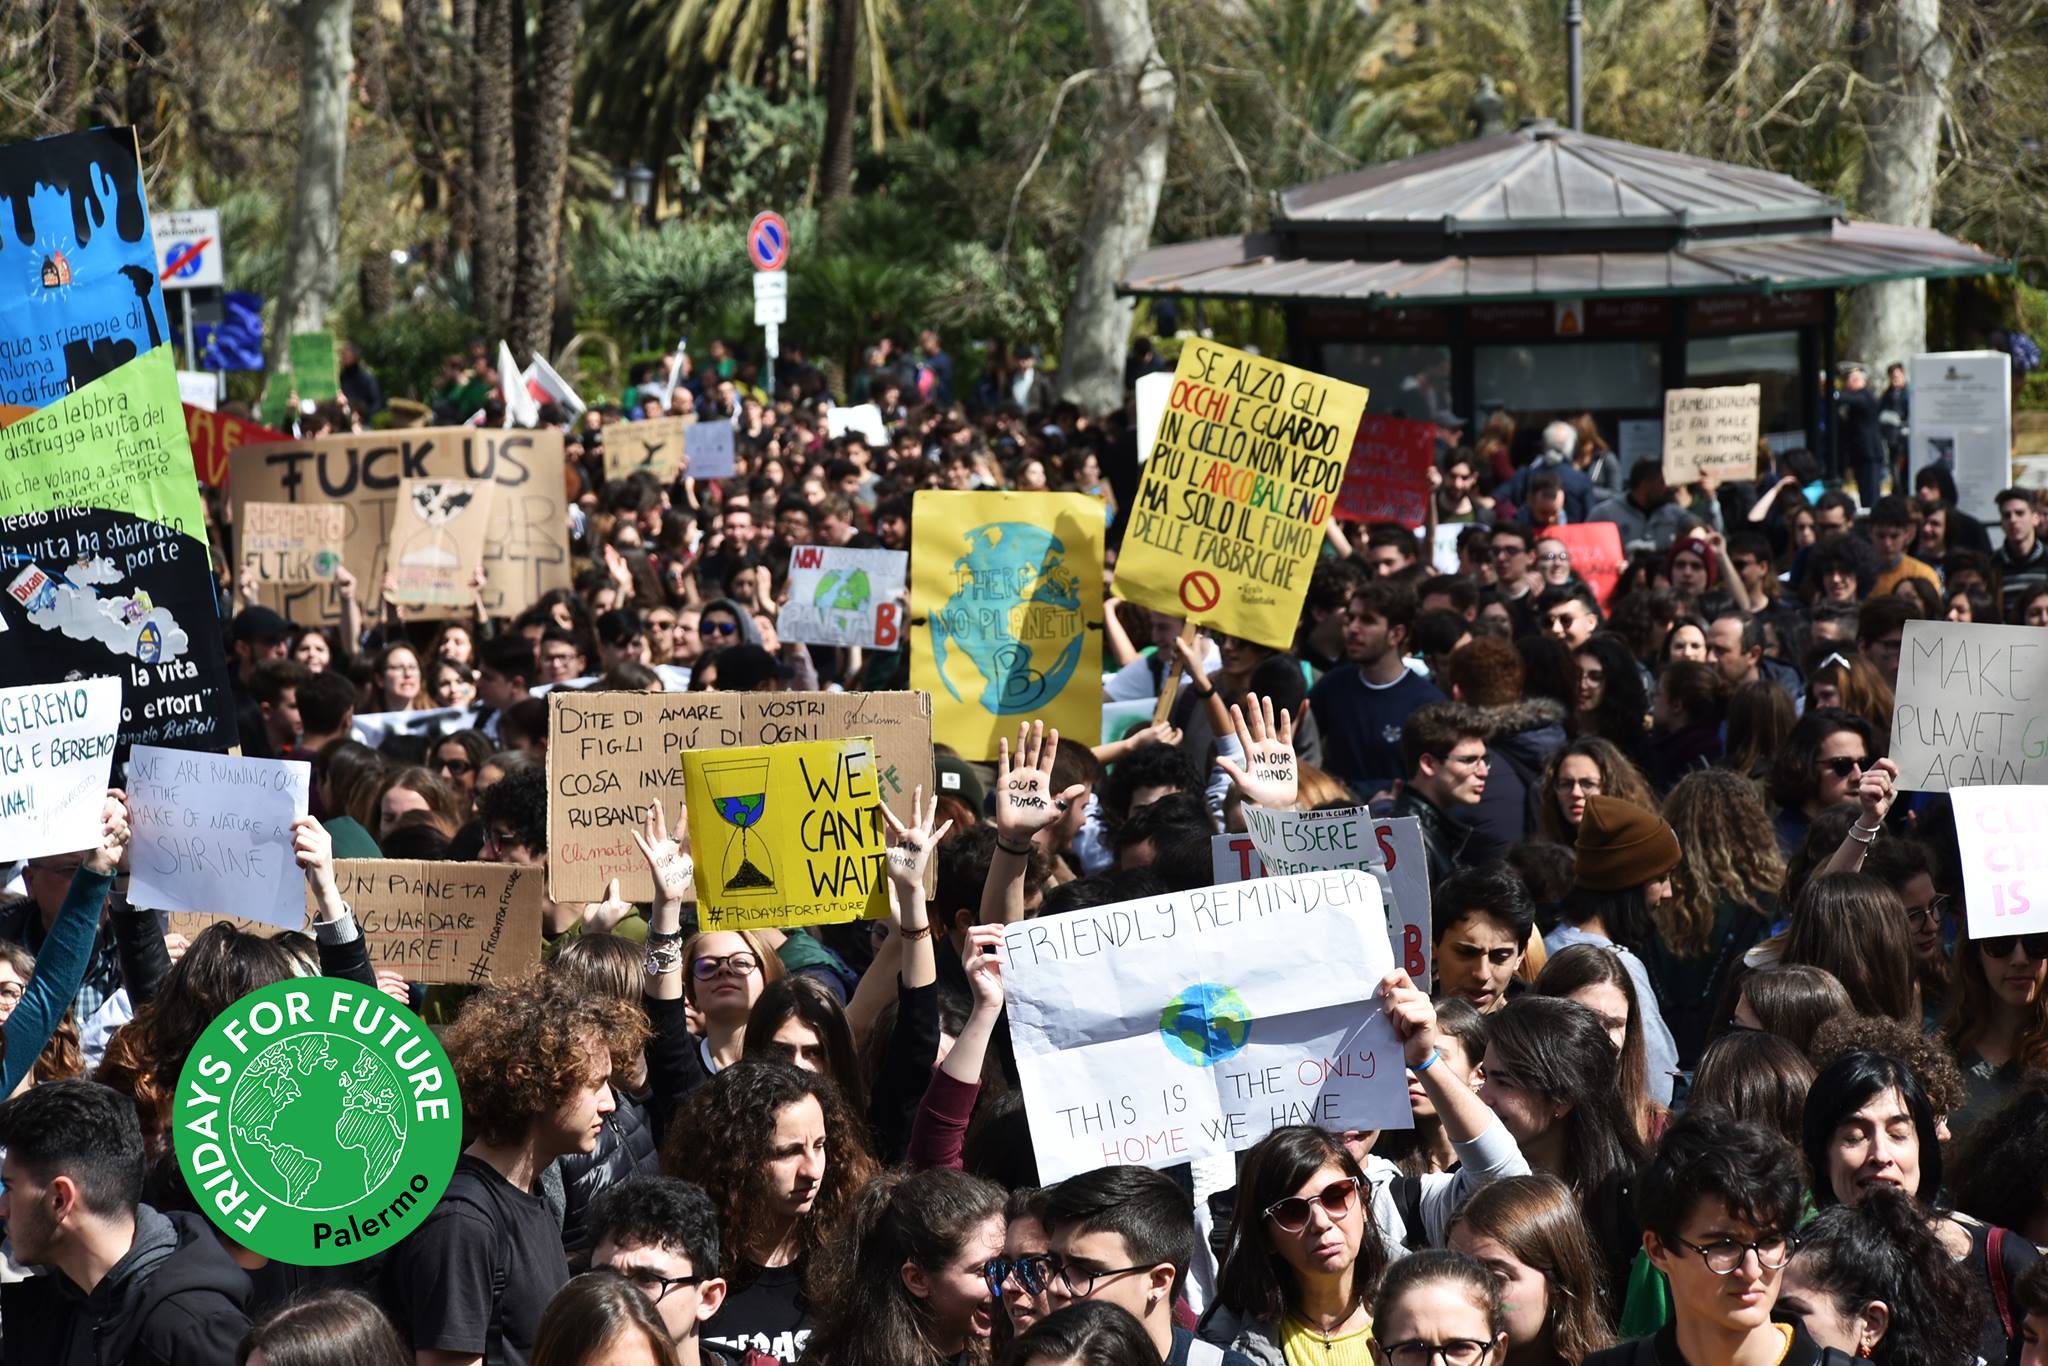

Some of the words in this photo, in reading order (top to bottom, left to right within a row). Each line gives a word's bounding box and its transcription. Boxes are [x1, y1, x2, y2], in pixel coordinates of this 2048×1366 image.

[39, 333, 52, 351] si
[55, 316, 121, 347] riempie
[126, 302, 142, 329] di
[22, 380, 38, 403] di
[1189, 347, 1223, 384] SE
[1224, 360, 1285, 403] ALZO
[1291, 382, 1327, 417] GLI
[63, 392, 128, 424] lebbra
[1170, 380, 1229, 423] OCCHI
[1230, 398, 1250, 428] E
[1251, 405, 1339, 456] GUARDO
[4, 429, 85, 461] distrugge
[116, 432, 162, 459] fiumi
[1160, 410, 1184, 444] IN
[1188, 419, 1247, 463] CIELO
[1246, 436, 1288, 477] NON
[1291, 450, 1342, 494] VEDO
[15, 472, 41, 496] che
[45, 466, 90, 489] volano
[96, 466, 106, 482] a
[110, 451, 170, 476] stento
[105, 475, 120, 491] di
[125, 464, 169, 484] morte
[266, 441, 435, 501] FUCK
[463, 436, 534, 486] US
[1140, 478, 1168, 514] MA
[1176, 489, 1234, 534] SOLO
[1236, 507, 1254, 543] IL
[1258, 515, 1313, 559] FUMO
[26, 537, 70, 563] vita
[76, 529, 100, 552] ha
[106, 516, 184, 549] sbarrato
[1133, 511, 1190, 555] DELLE
[1193, 531, 1300, 590] FABBRICHE
[126, 541, 180, 577] porte
[14, 571, 45, 601] Dixan
[950, 567, 1036, 600] THERE
[874, 602, 897, 646] B
[938, 606, 970, 640] NO
[979, 606, 1079, 641] PLANET
[131, 663, 150, 687] la
[156, 659, 199, 683] vita
[993, 643, 1045, 708] B
[1912, 637, 2039, 701] MAKE
[162, 716, 218, 740] Bertoli
[624, 710, 643, 726] DI
[659, 705, 724, 724] AMARE
[759, 700, 825, 719] VOSTRI
[1897, 704, 2014, 756] PLANET
[31, 742, 43, 769] E
[50, 733, 115, 767] BERREMO
[580, 736, 643, 760] FIGLI
[721, 729, 742, 746] DI
[760, 723, 818, 744] OGNI
[1253, 752, 1266, 764] IN
[1270, 752, 1292, 765] OUR
[133, 755, 165, 782] WE
[175, 759, 201, 784] ARE
[210, 761, 268, 788] RUNNING
[559, 770, 621, 797] COSA
[799, 752, 871, 803] WE
[1008, 780, 1038, 791] OUR
[1256, 768, 1293, 782] HANDS
[1920, 754, 2025, 788] AGAIN
[150, 784, 182, 805] TIME
[1008, 794, 1047, 810] FUTURE
[130, 805, 174, 826] MAKE
[183, 807, 199, 828] OF
[210, 812, 263, 835] NATURE
[273, 825, 284, 838] A
[800, 806, 882, 852] CAN'T
[1245, 808, 1276, 845] NON
[1281, 821, 1358, 852] ESSERE
[153, 836, 266, 879] SHRINE
[656, 854, 675, 869] OUR
[807, 853, 887, 898] WAIT
[334, 872, 375, 895] UN
[389, 874, 487, 900] PIANETA
[664, 866, 692, 887] FUTURE
[1992, 881, 2030, 917] IS
[1004, 903, 1176, 970] FRIENDLY
[1404, 924, 1426, 977] B
[1056, 1095, 1136, 1139] THIS
[1163, 1084, 1187, 1115] IS
[1225, 1066, 1285, 1099] THE
[1297, 1050, 1375, 1087] ONLY
[1102, 1128, 1189, 1166] HOME
[1200, 1112, 1248, 1142] WE
[1271, 1093, 1341, 1131] HAVE
